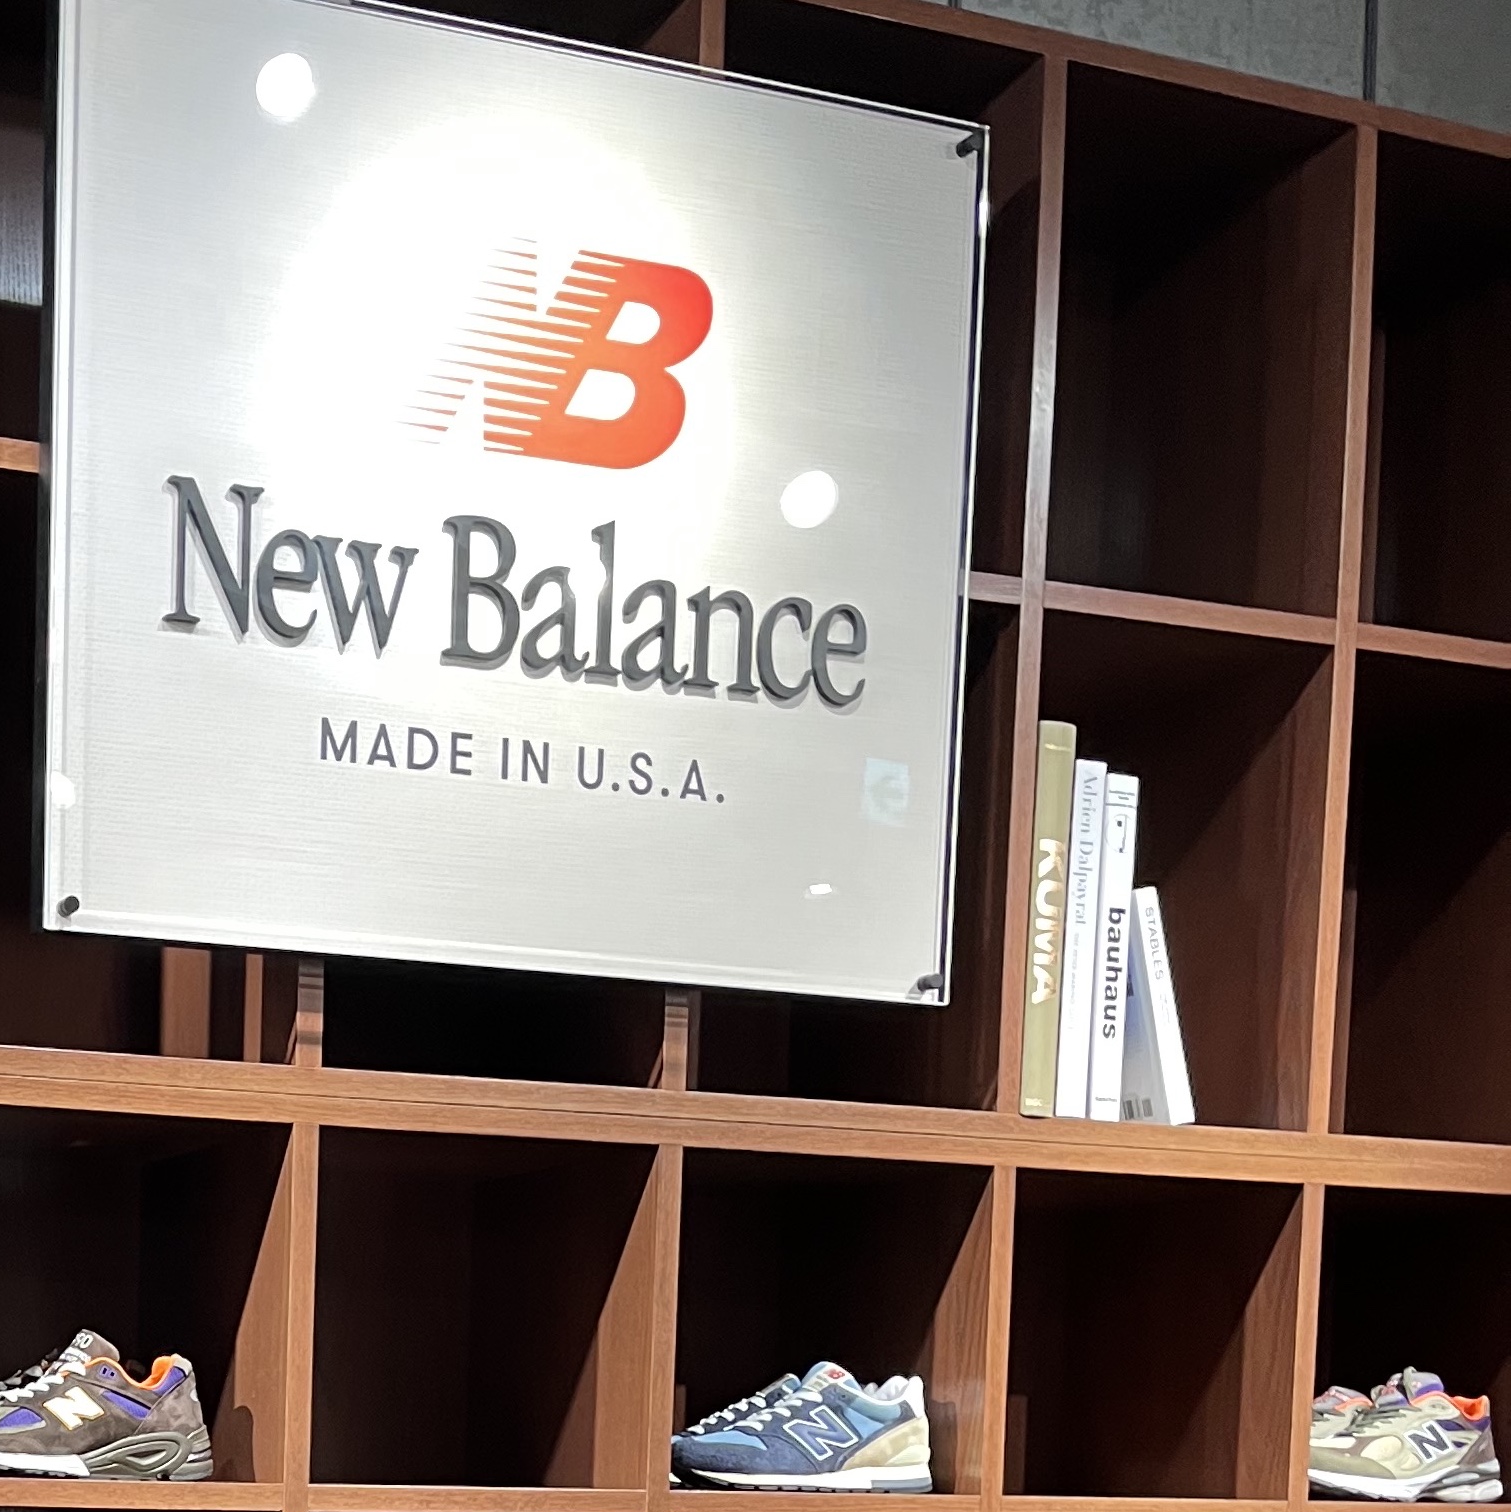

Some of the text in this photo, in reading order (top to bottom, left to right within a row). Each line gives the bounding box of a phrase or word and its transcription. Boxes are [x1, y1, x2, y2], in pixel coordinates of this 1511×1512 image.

[160, 475, 869, 711] New Balance
[318, 716, 727, 806] MADE IN U.S.A.
[1080, 773, 1098, 833] Adrien
[1032, 838, 1065, 1005] KUMA
[1145, 906, 1164, 981] STABLES
[1102, 906, 1126, 1040] bauhaus
[42, 1386, 105, 1431] N
[783, 1404, 859, 1461] N
[1405, 1421, 1451, 1462] N
